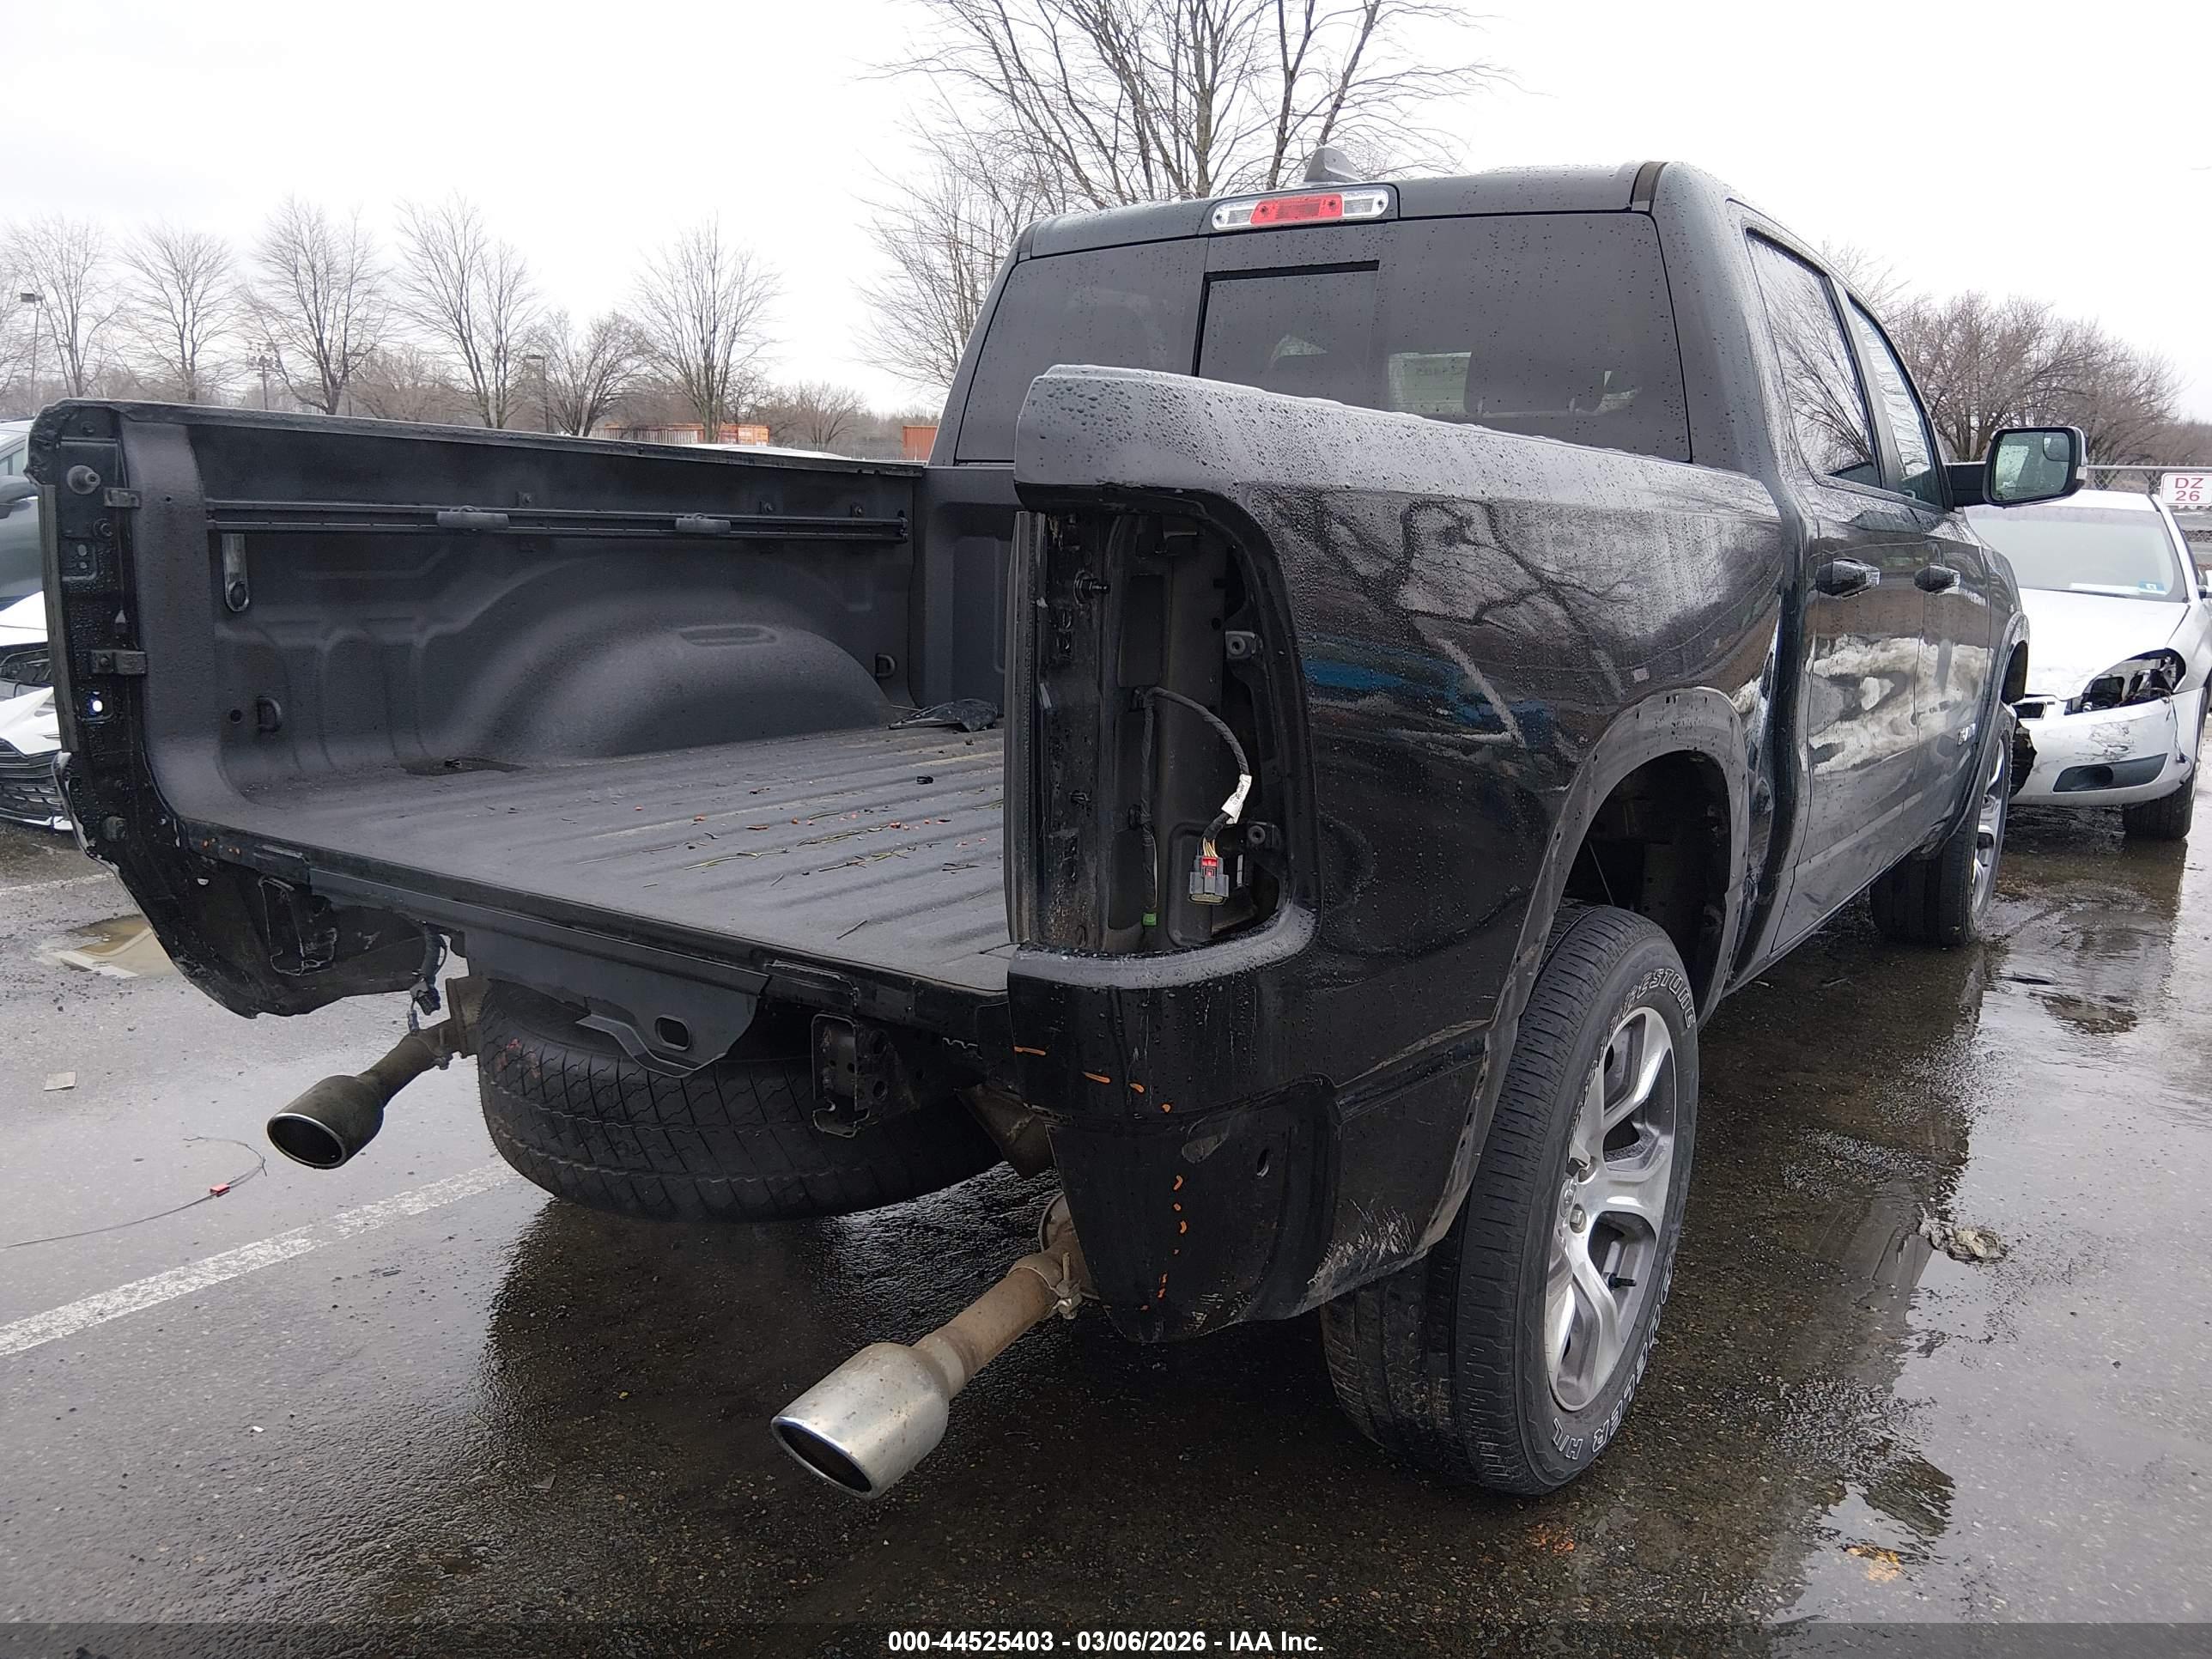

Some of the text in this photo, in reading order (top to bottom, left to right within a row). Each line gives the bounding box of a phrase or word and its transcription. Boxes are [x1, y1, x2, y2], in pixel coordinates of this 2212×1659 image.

[2174, 477, 2205, 489] DZ
[2174, 490, 2201, 502] 26
[1552, 1255, 1674, 1460] DUELER H/L
